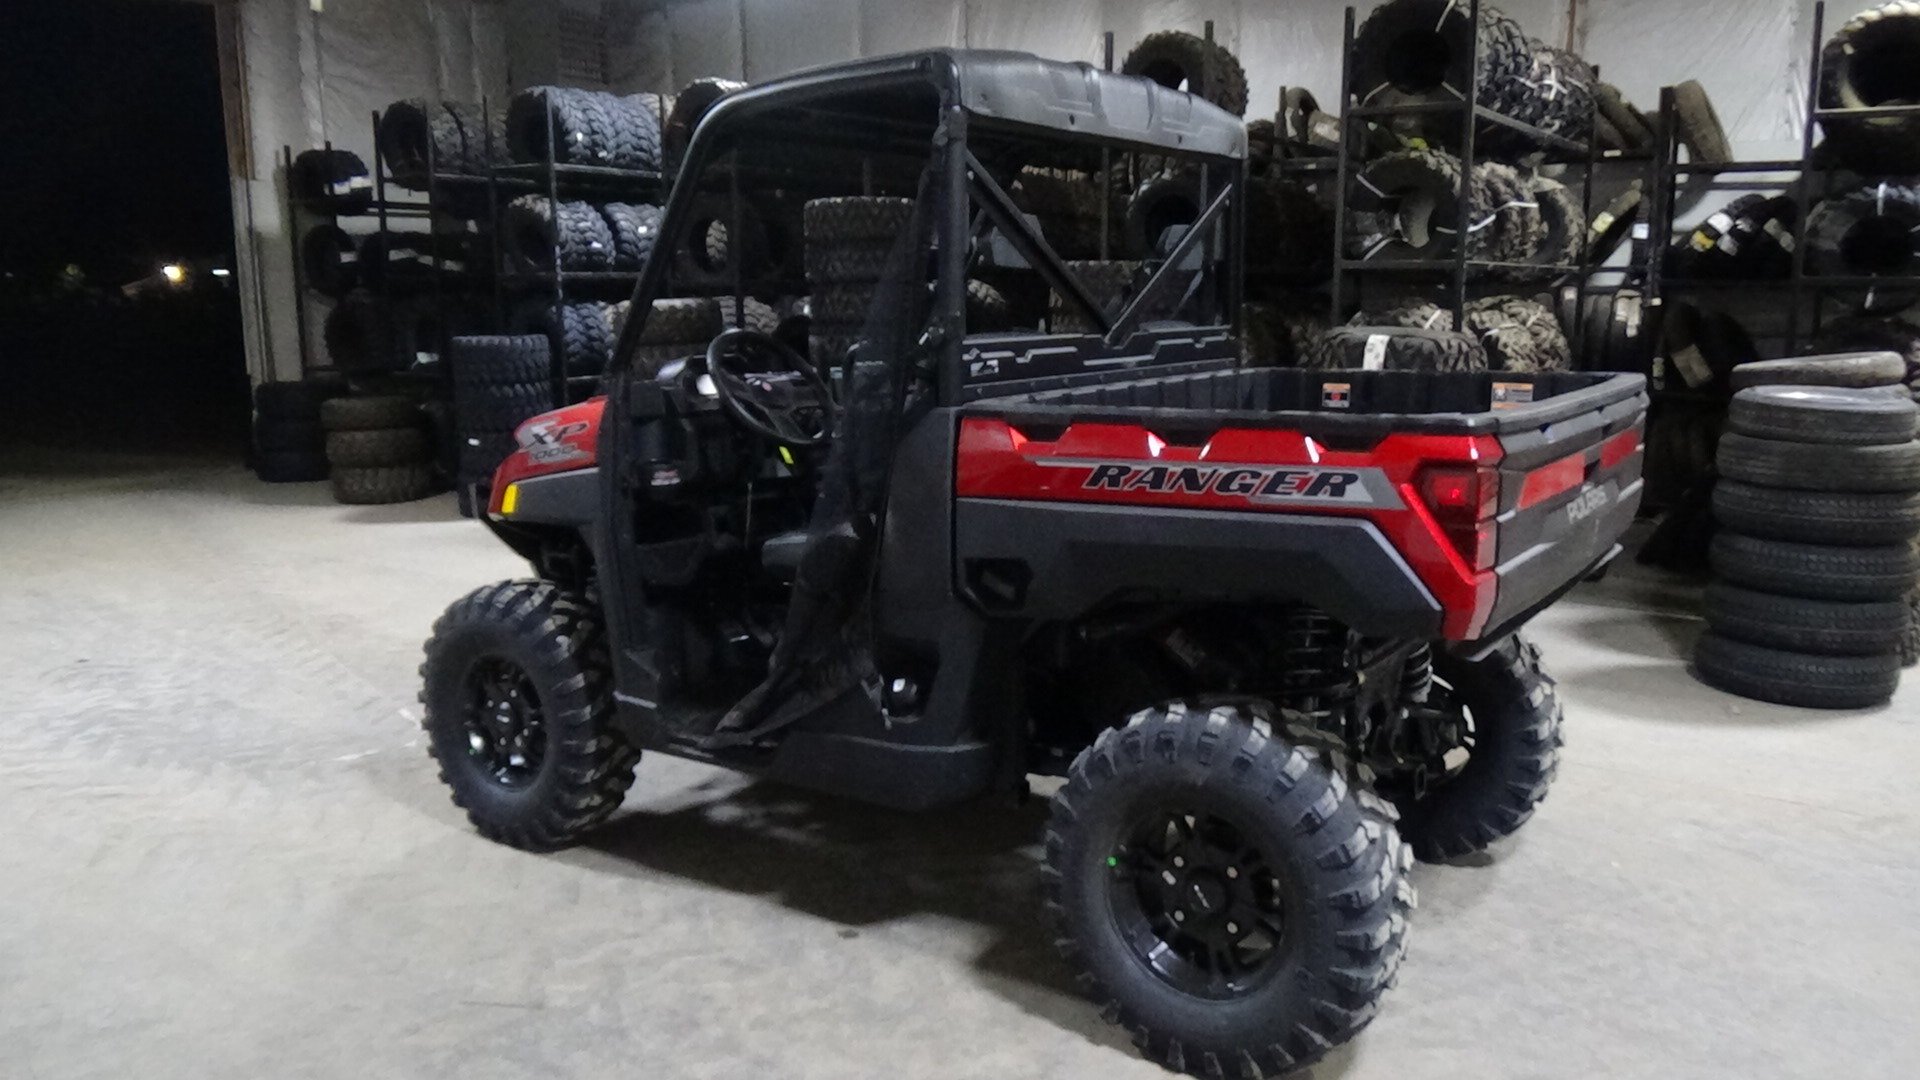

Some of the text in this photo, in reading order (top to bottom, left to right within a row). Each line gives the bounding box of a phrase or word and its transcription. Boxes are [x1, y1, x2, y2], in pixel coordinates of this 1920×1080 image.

[524, 422, 588, 449] XP
[533, 444, 576, 460] 000
[1084, 463, 1361, 498] RANGER
